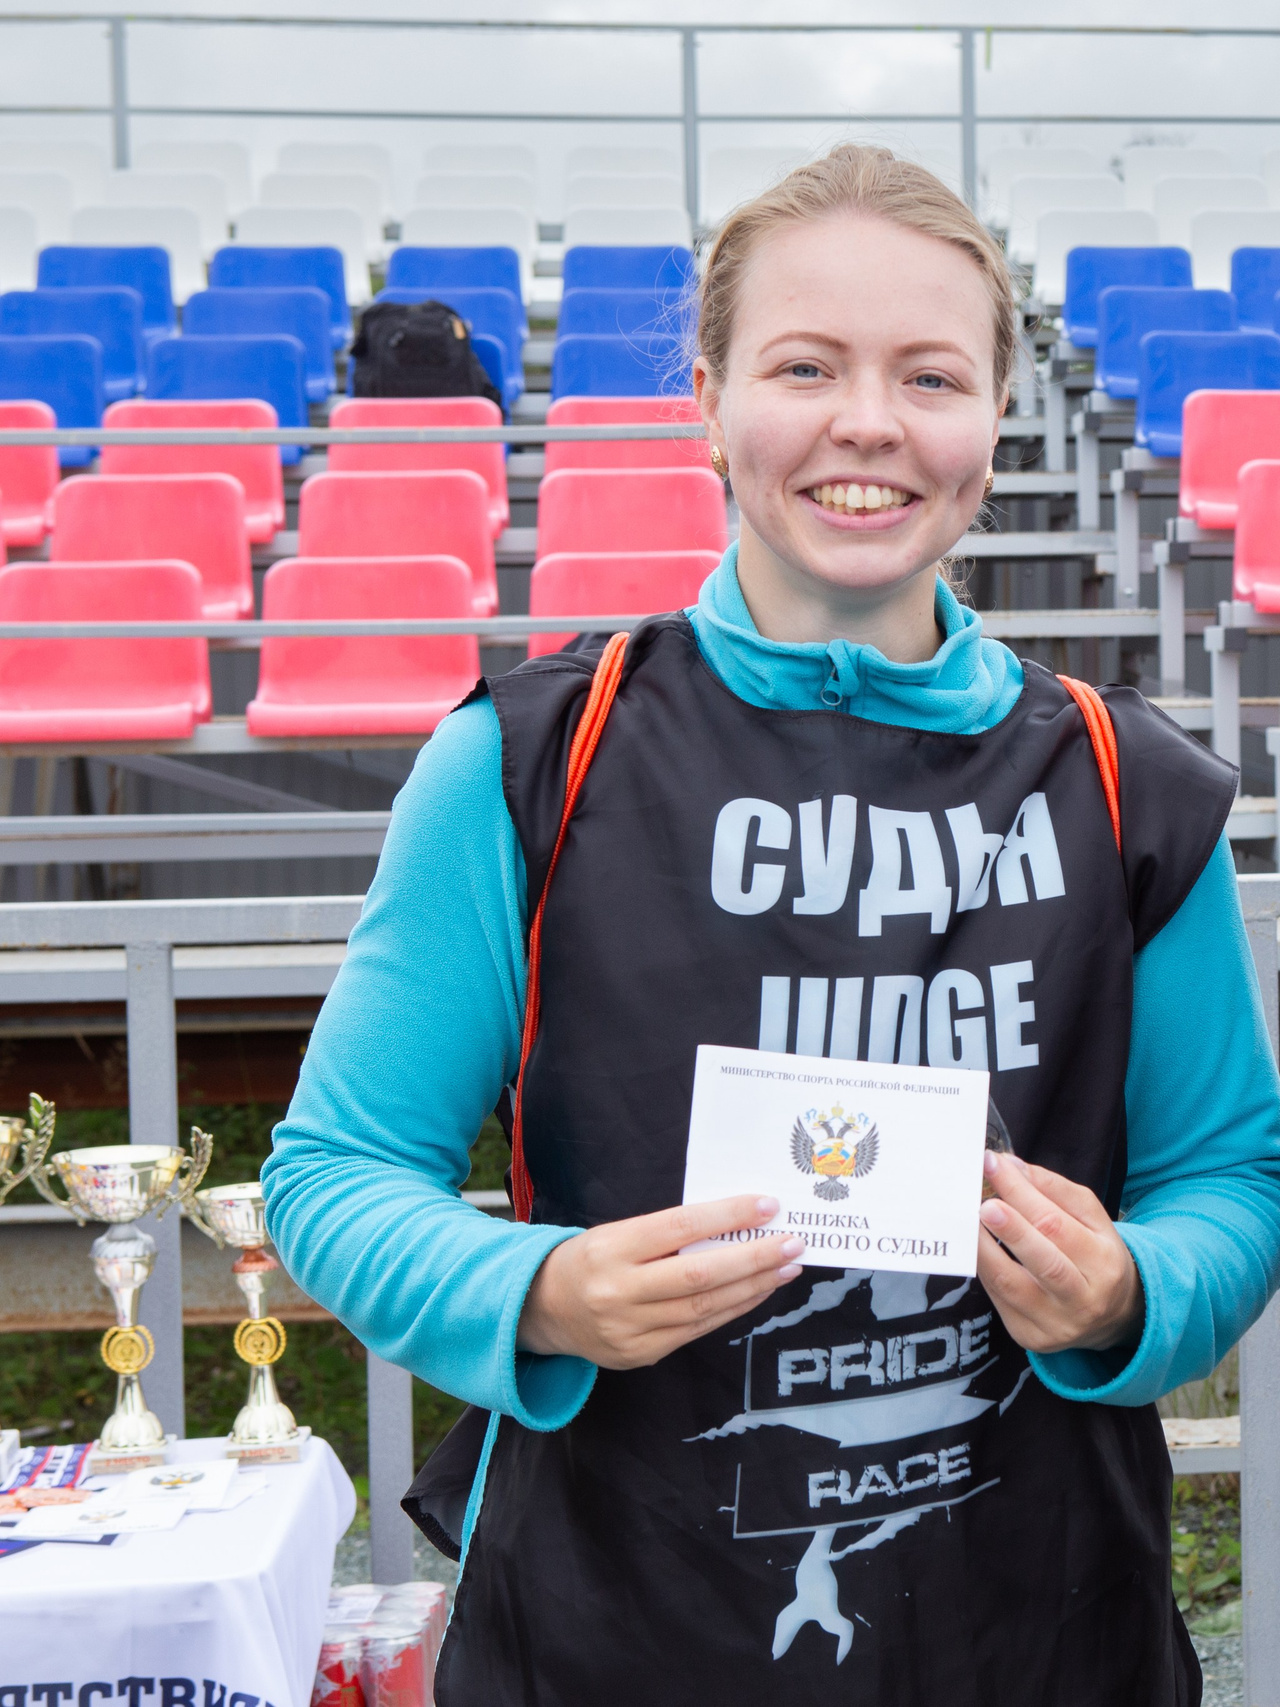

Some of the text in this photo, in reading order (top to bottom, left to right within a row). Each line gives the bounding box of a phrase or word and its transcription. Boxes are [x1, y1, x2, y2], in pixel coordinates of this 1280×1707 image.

[711, 792, 1066, 937] СУДЬЯ
[719, 1065, 961, 1097] МИНИСТЕРСТВО СПОРТА РОССИЙСКОЙ ФЕДЕРАЦИИ
[786, 1211, 870, 1230] КНИЖКА
[877, 1235, 949, 1259] СУДЬИ
[777, 1311, 993, 1397] PRIDE
[808, 1441, 972, 1509] RACE
